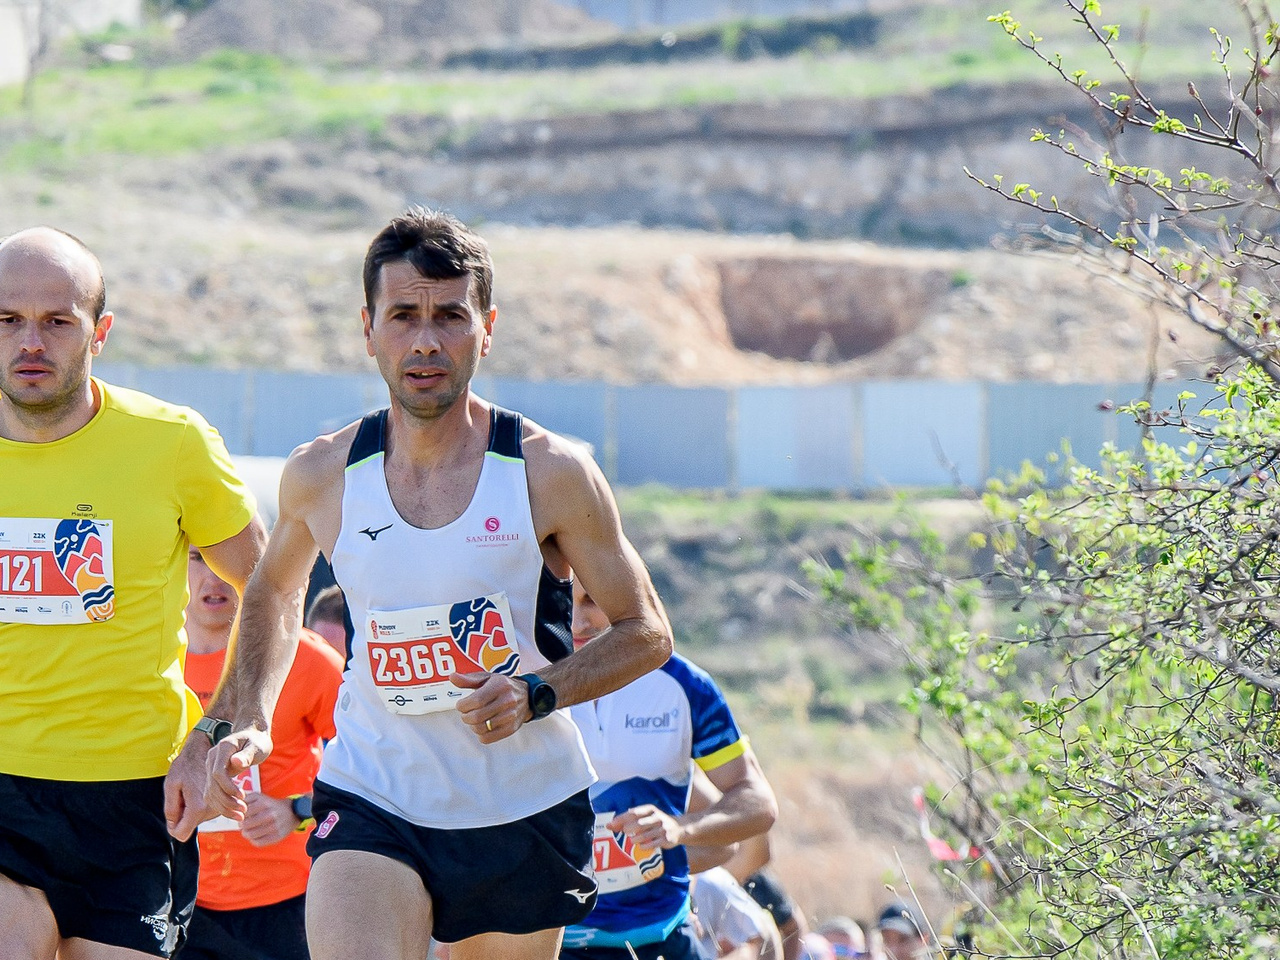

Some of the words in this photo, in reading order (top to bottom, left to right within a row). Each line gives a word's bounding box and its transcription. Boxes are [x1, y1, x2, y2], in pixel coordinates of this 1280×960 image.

[465, 533, 519, 542] SANTORELLI
[371, 641, 456, 682] 2366
[625, 712, 670, 729] karoll
